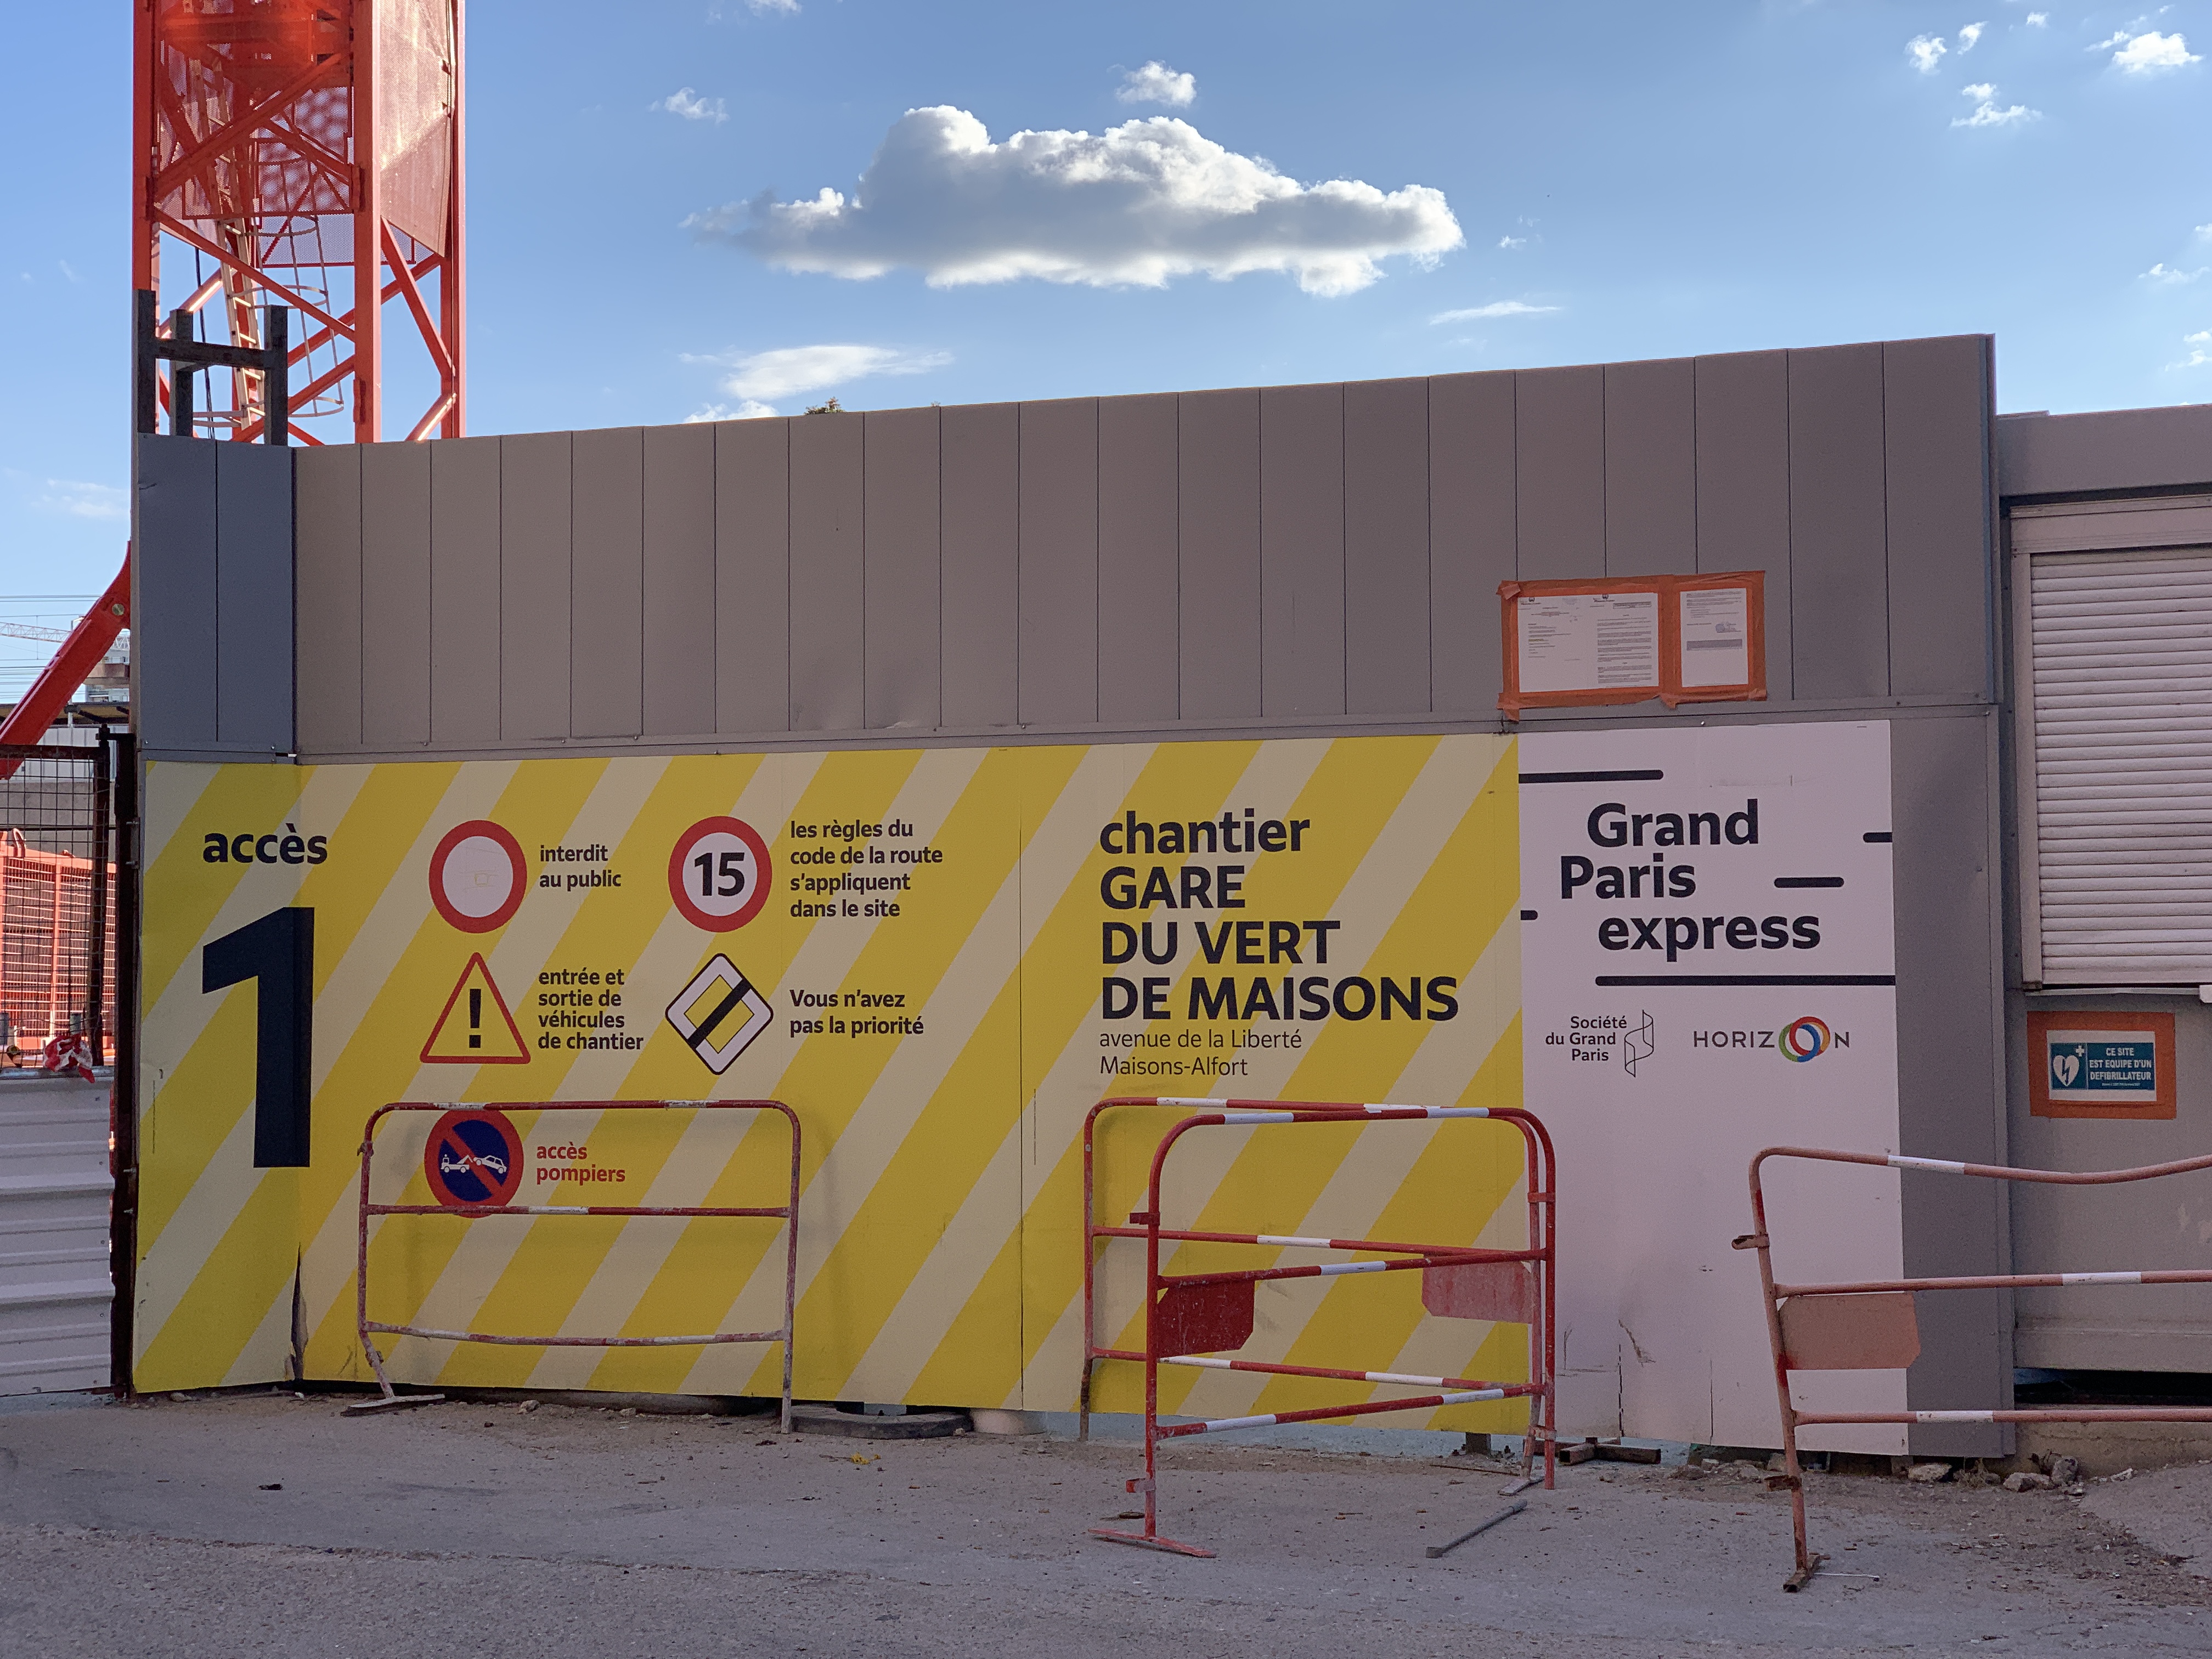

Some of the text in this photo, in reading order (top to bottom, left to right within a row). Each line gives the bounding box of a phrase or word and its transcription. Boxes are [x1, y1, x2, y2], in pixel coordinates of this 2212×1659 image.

[791, 819, 912, 842] les règles du
[1100, 808, 1310, 854] chantier
[1588, 799, 1759, 848] Grand
[203, 823, 328, 865] accès
[540, 844, 608, 862] interdit
[791, 845, 943, 864] code de la route
[539, 870, 621, 892] au public
[694, 851, 745, 896] 15
[1561, 853, 1696, 899] Paris
[790, 873, 911, 895] s'appliquent
[1101, 865, 1245, 909] GARE
[791, 899, 900, 917] dans le site
[1102, 921, 1340, 964] DU VERT
[1598, 916, 1821, 962] express
[539, 967, 624, 985] entrée et
[538, 990, 621, 1006] sortie de
[789, 989, 905, 1007] Vous n'avez
[1102, 977, 1459, 1020] DE MAISONS
[538, 1011, 624, 1028] véhicules
[790, 1016, 924, 1038] pas la priorité
[1571, 1016, 1627, 1029] Société
[202, 907, 314, 1168] 1
[538, 1032, 644, 1049] de chantier
[1100, 1029, 1302, 1048] avenue de la Liberté
[1545, 1032, 1616, 1045] du Grand
[1572, 1049, 1609, 1061] Paris
[2106, 1047, 2134, 1056] CE SITE
[1101, 1057, 1248, 1076] Maisons-Alfort
[2089, 1059, 2152, 1069] EST EQUIPE D'UN
[2090, 1071, 2152, 1081] DEFIBRILLATEUR
[537, 1142, 587, 1159] accès
[537, 1165, 625, 1185] pompiers
